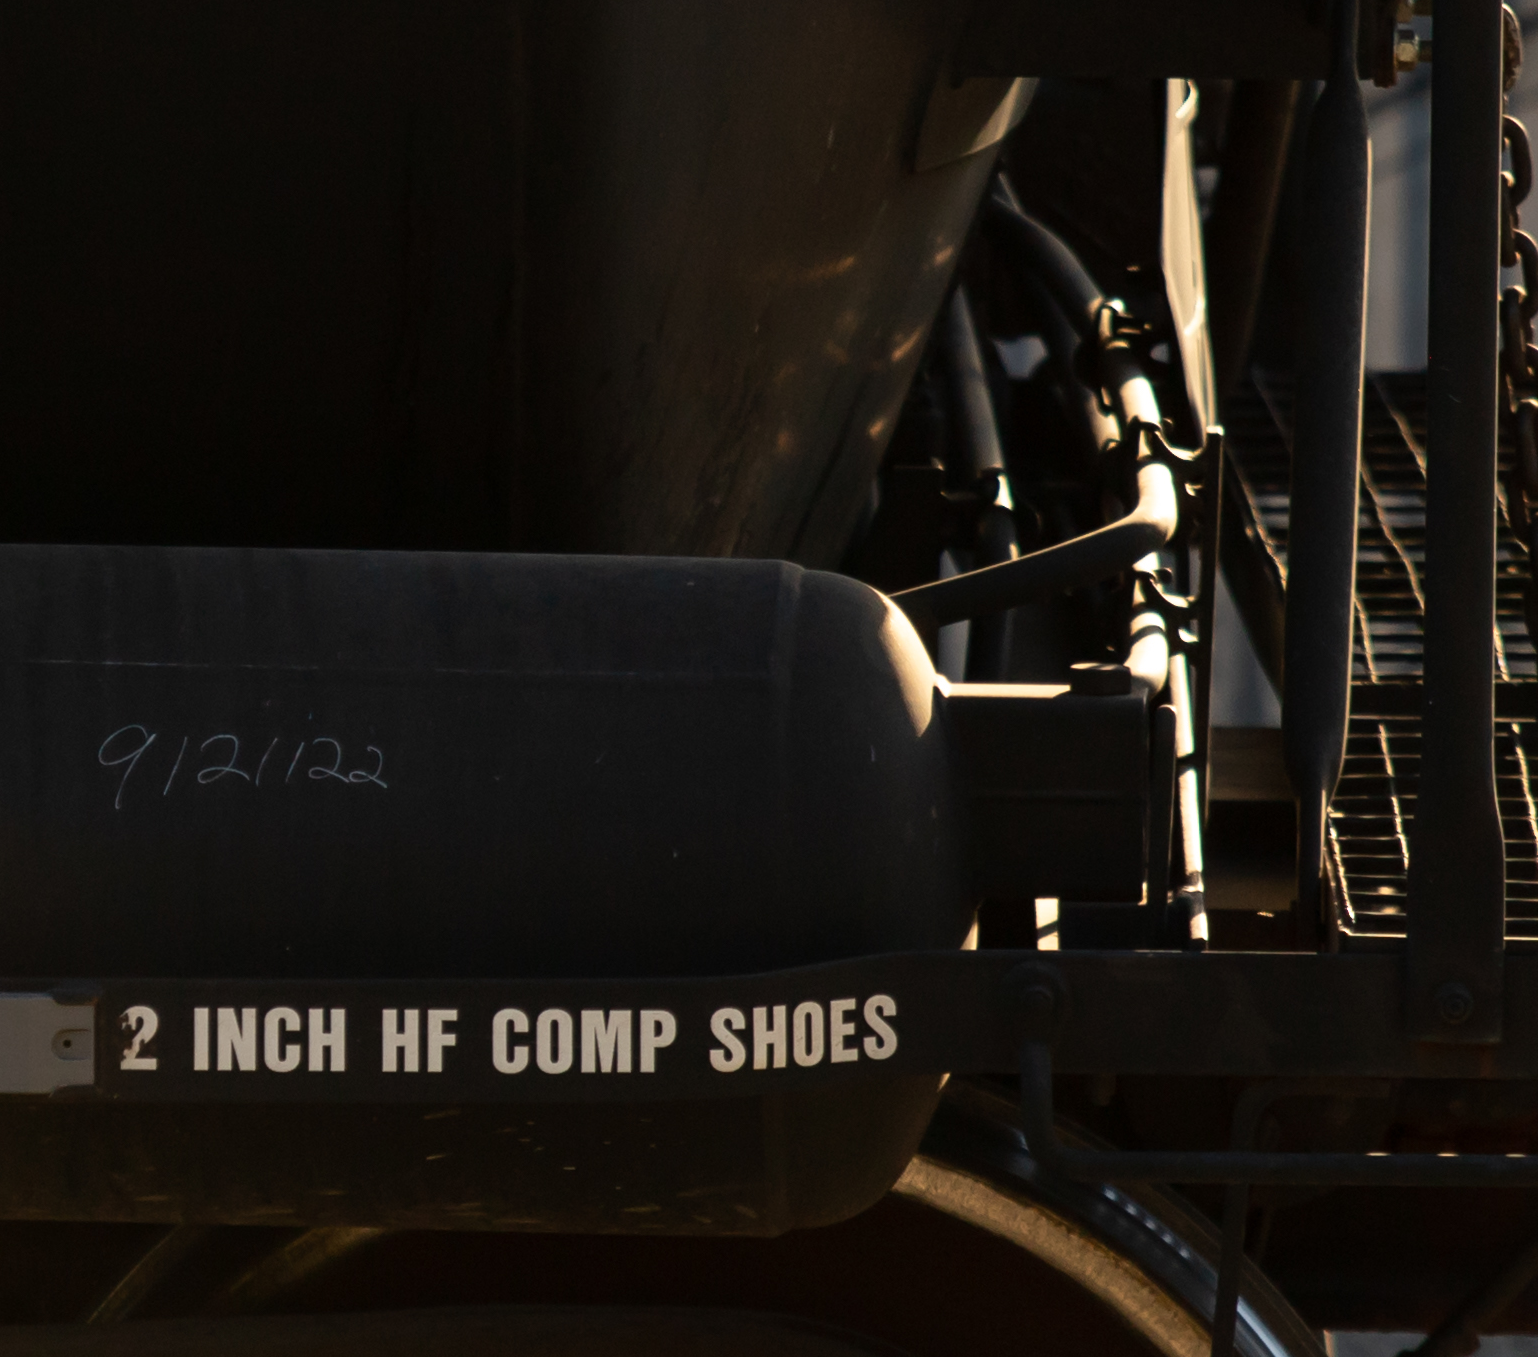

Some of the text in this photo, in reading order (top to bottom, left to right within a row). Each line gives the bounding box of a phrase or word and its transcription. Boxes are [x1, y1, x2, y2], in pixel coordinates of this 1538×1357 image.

[120, 994, 898, 1075] 2 INCH HF COMP SHOES
